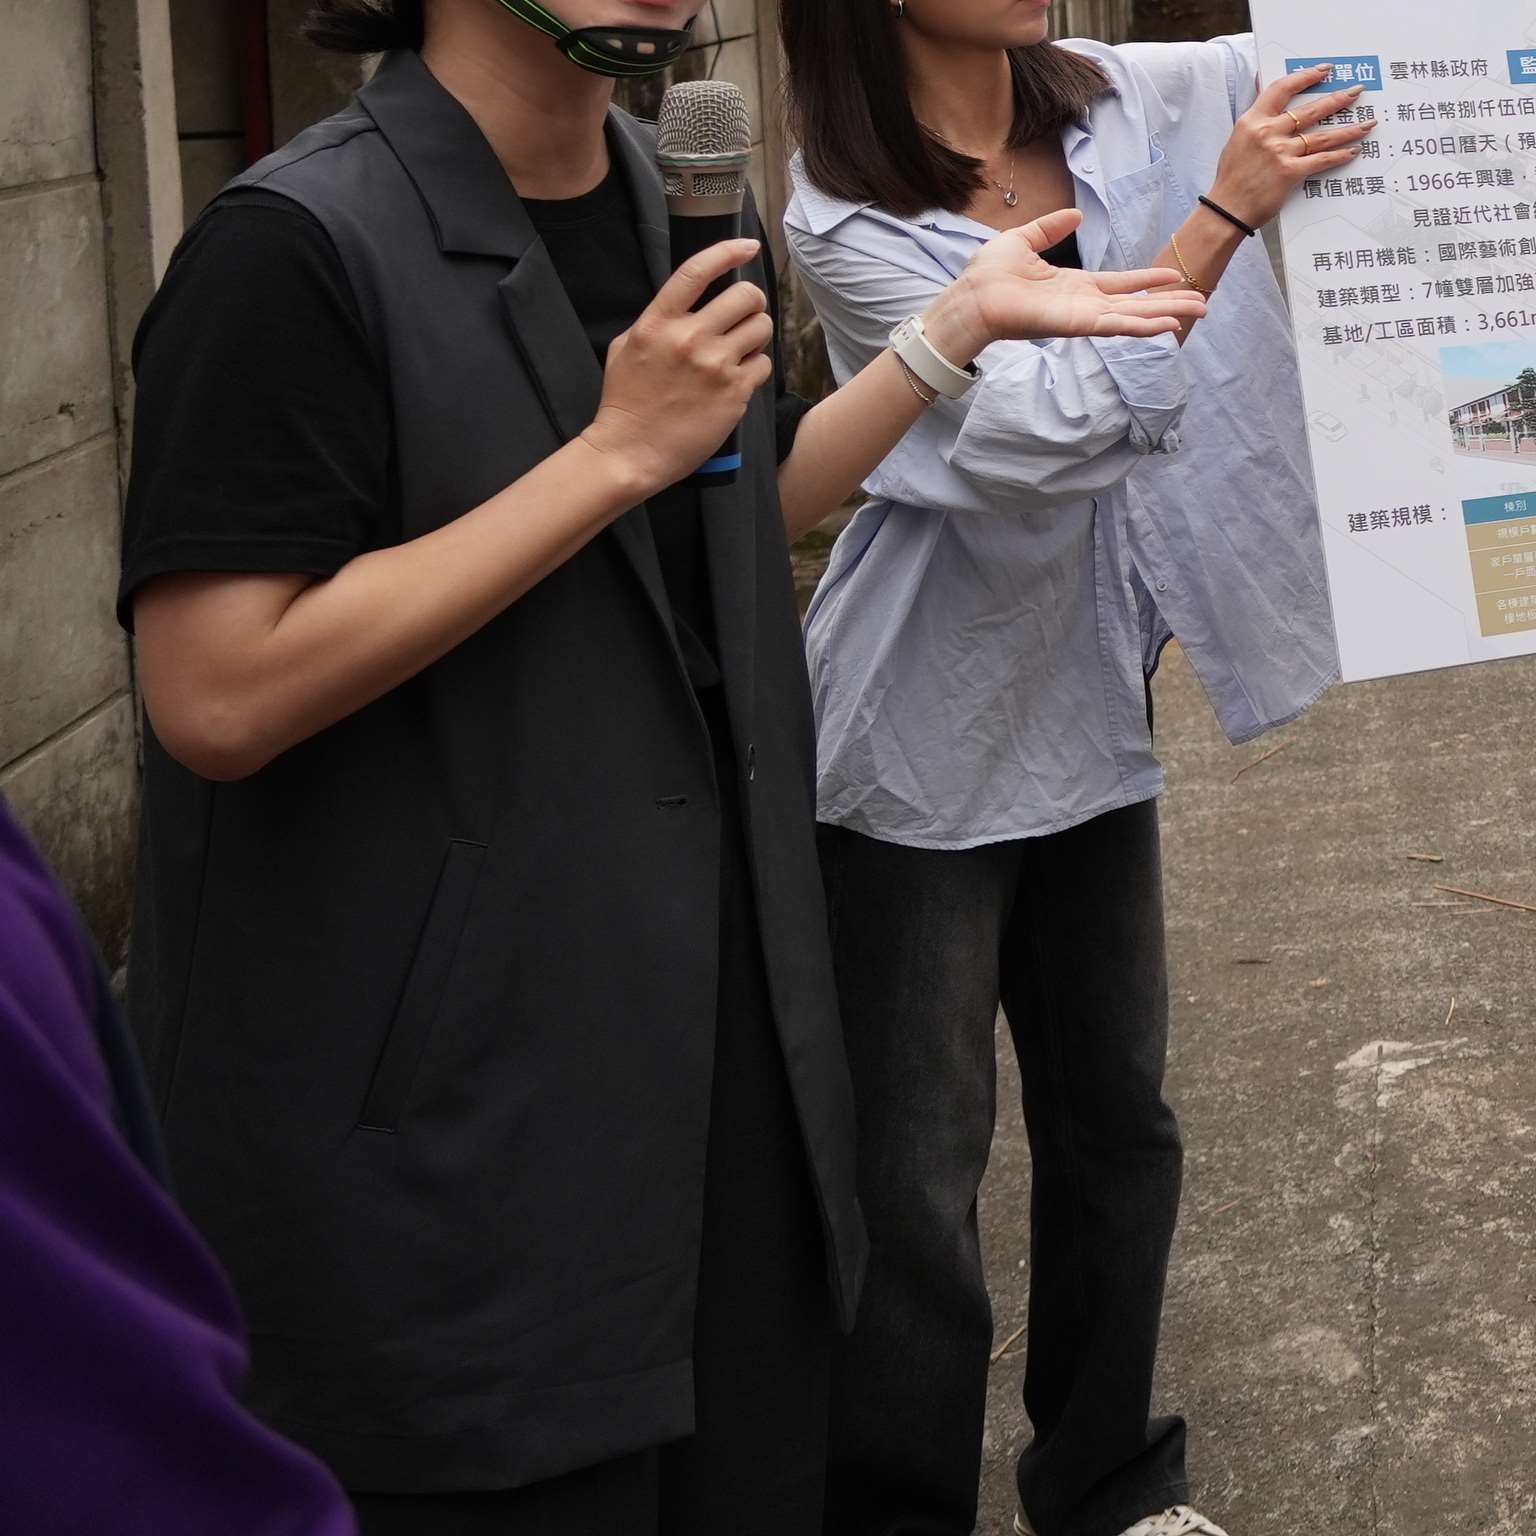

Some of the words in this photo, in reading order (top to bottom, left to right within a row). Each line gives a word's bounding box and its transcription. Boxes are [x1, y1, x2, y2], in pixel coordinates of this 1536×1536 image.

[1389, 59, 1489, 81] 雲林縣政府
